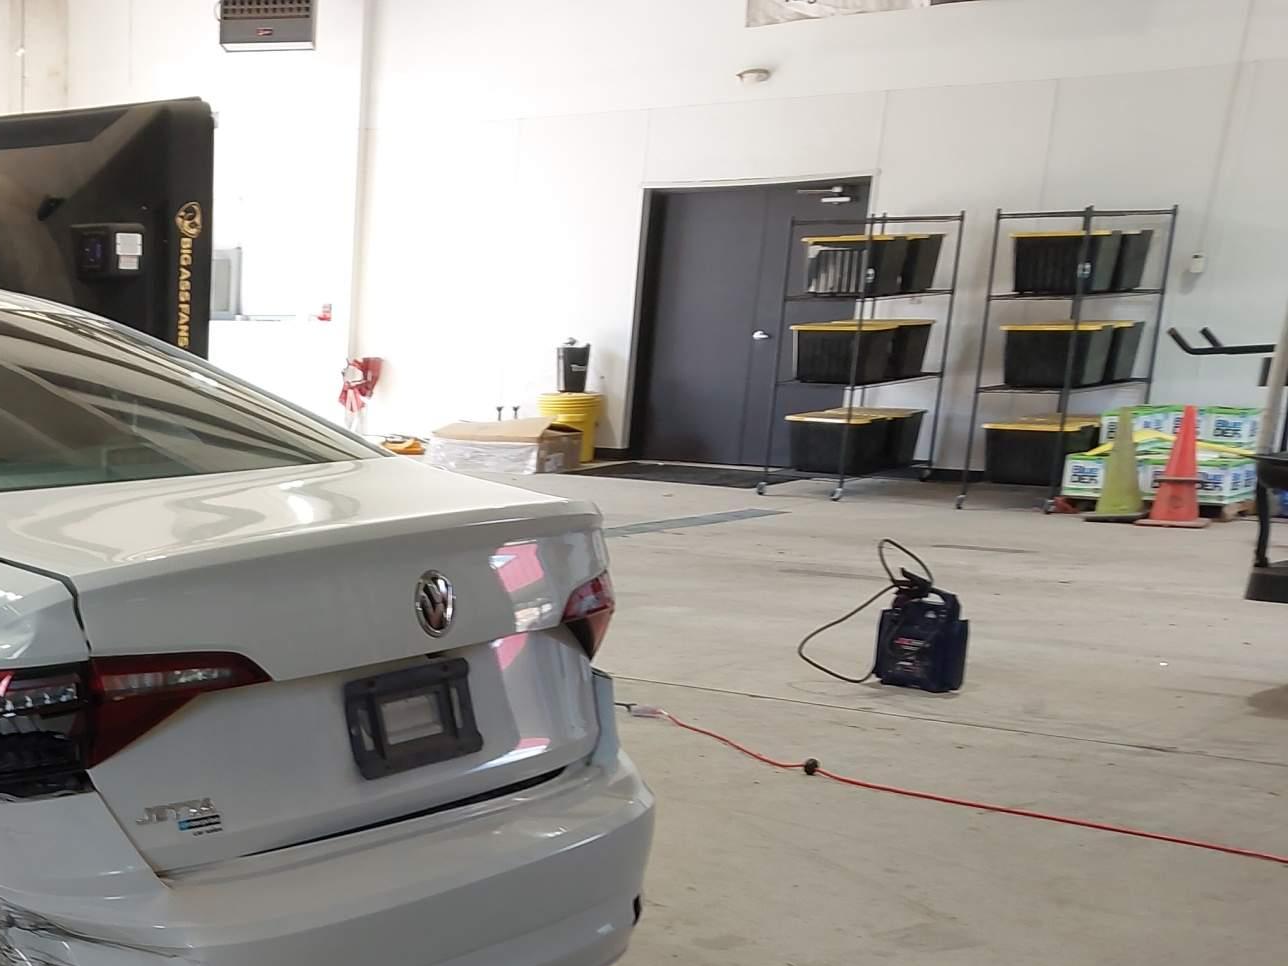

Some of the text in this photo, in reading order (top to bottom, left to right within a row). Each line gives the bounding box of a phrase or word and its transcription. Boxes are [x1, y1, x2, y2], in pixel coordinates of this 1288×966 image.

[177, 237, 193, 348] BIG ASS FANS
[135, 797, 216, 825] JETTA
